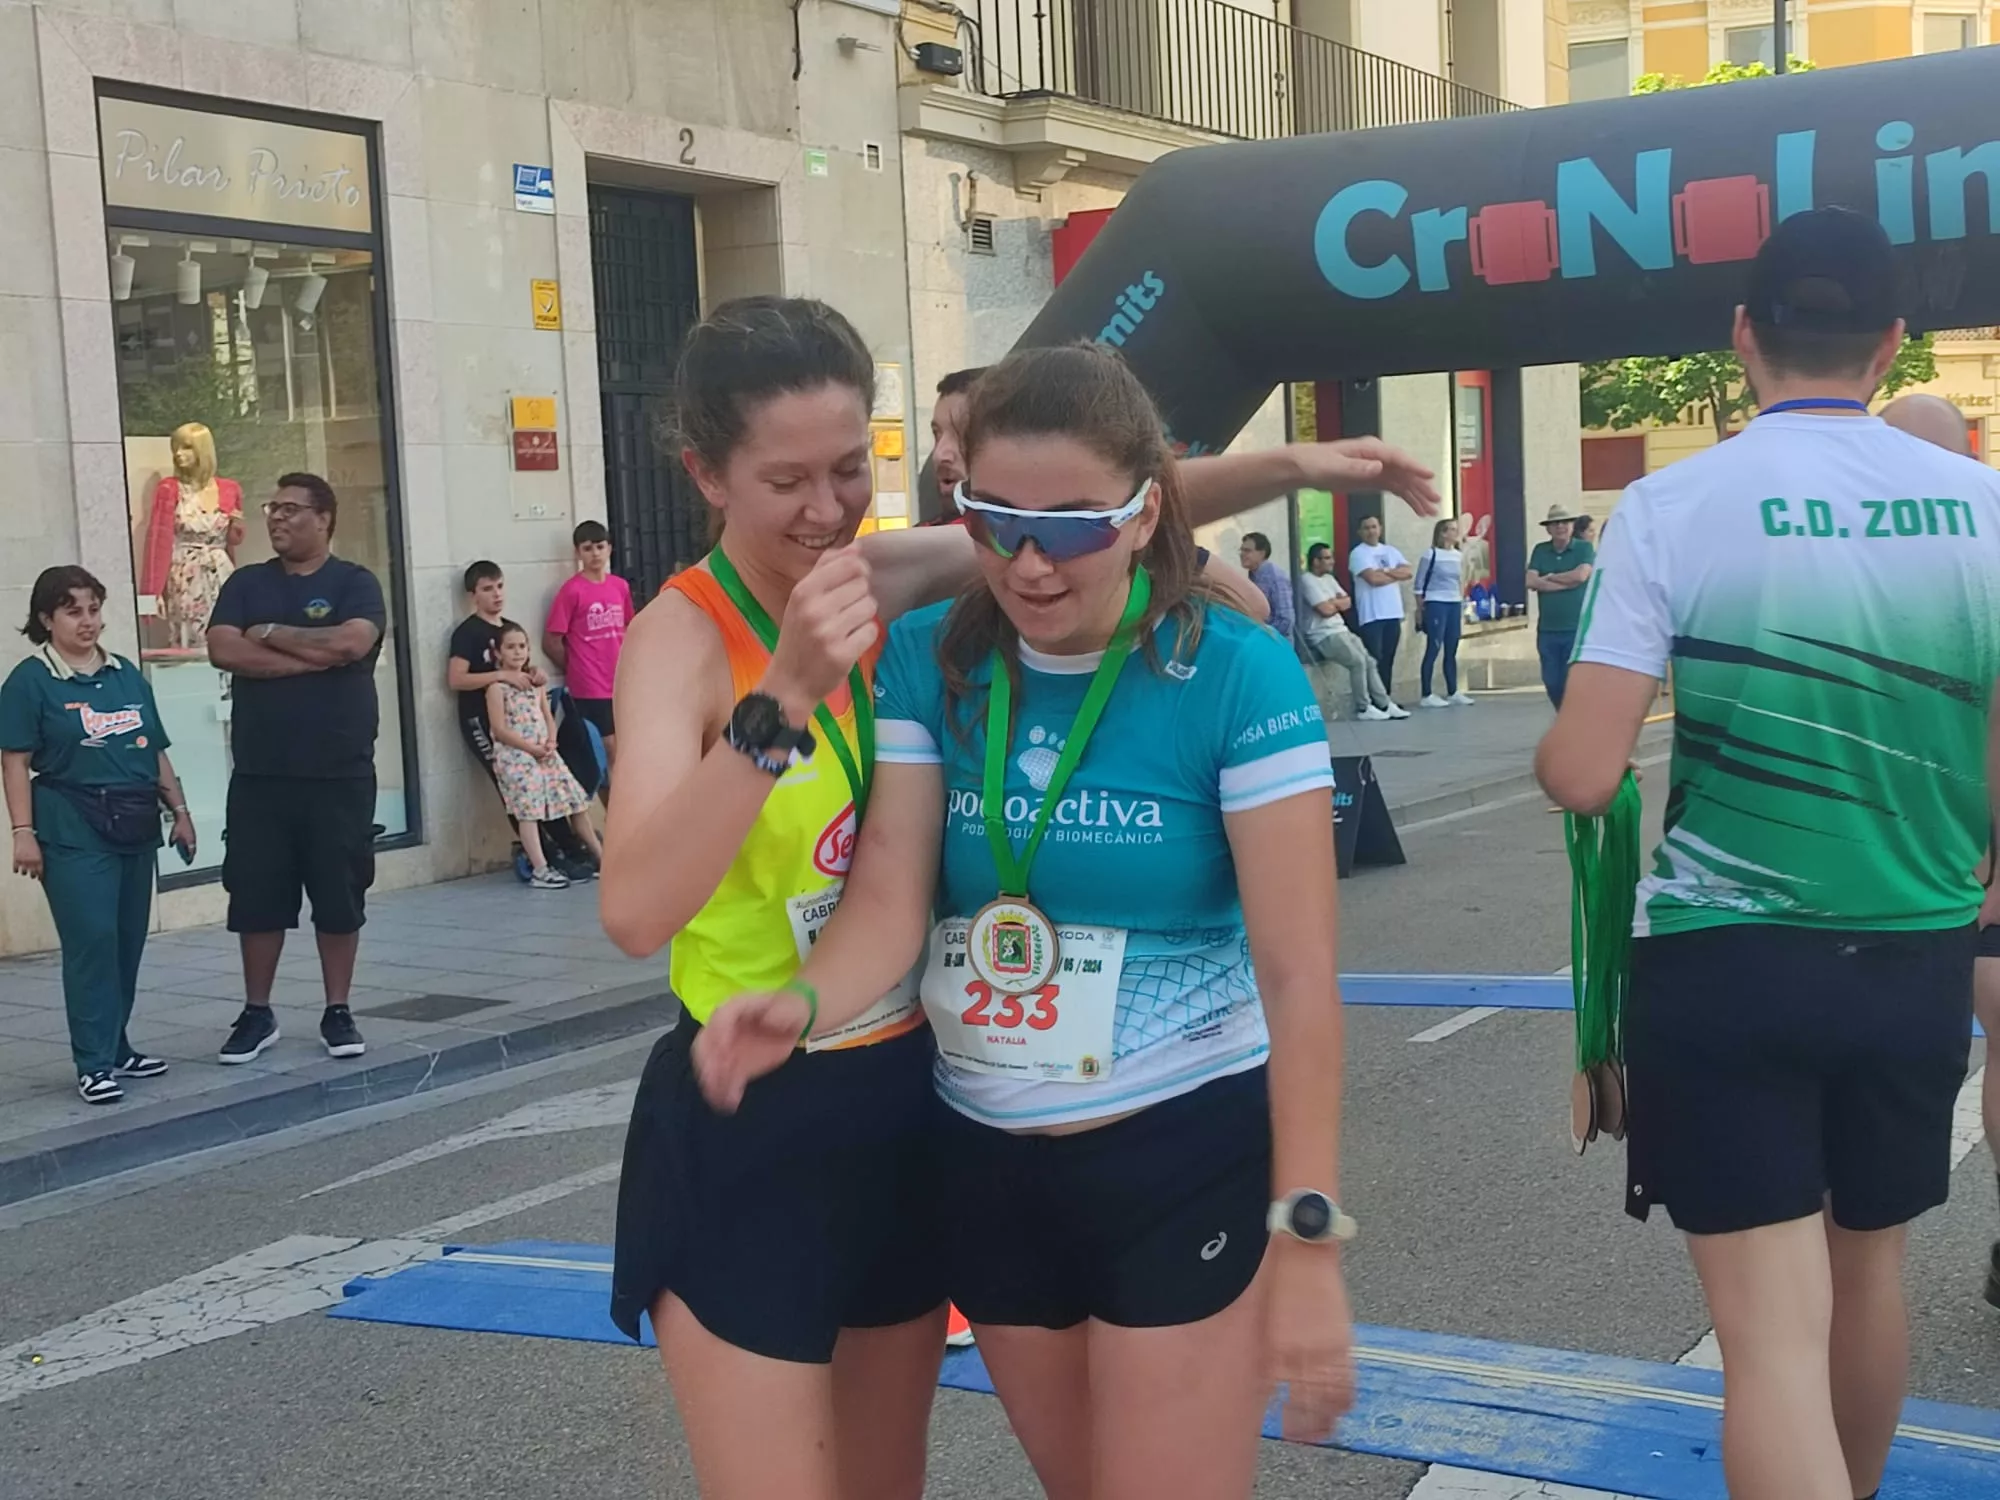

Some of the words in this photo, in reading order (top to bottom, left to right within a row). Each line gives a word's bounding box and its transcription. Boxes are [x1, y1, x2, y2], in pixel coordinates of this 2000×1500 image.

[678, 127, 697, 166] 2
[115, 128, 232, 193] Pilar
[248, 146, 361, 208] Prieto
[1759, 497, 1850, 538] C.D.
[1860, 497, 1978, 538] ZOITI
[1055, 829, 1164, 844] BIOMECÁNICA
[1056, 930, 1095, 941] KODA
[960, 980, 1060, 1031] 233
[986, 1035, 1027, 1046] NATALIA
